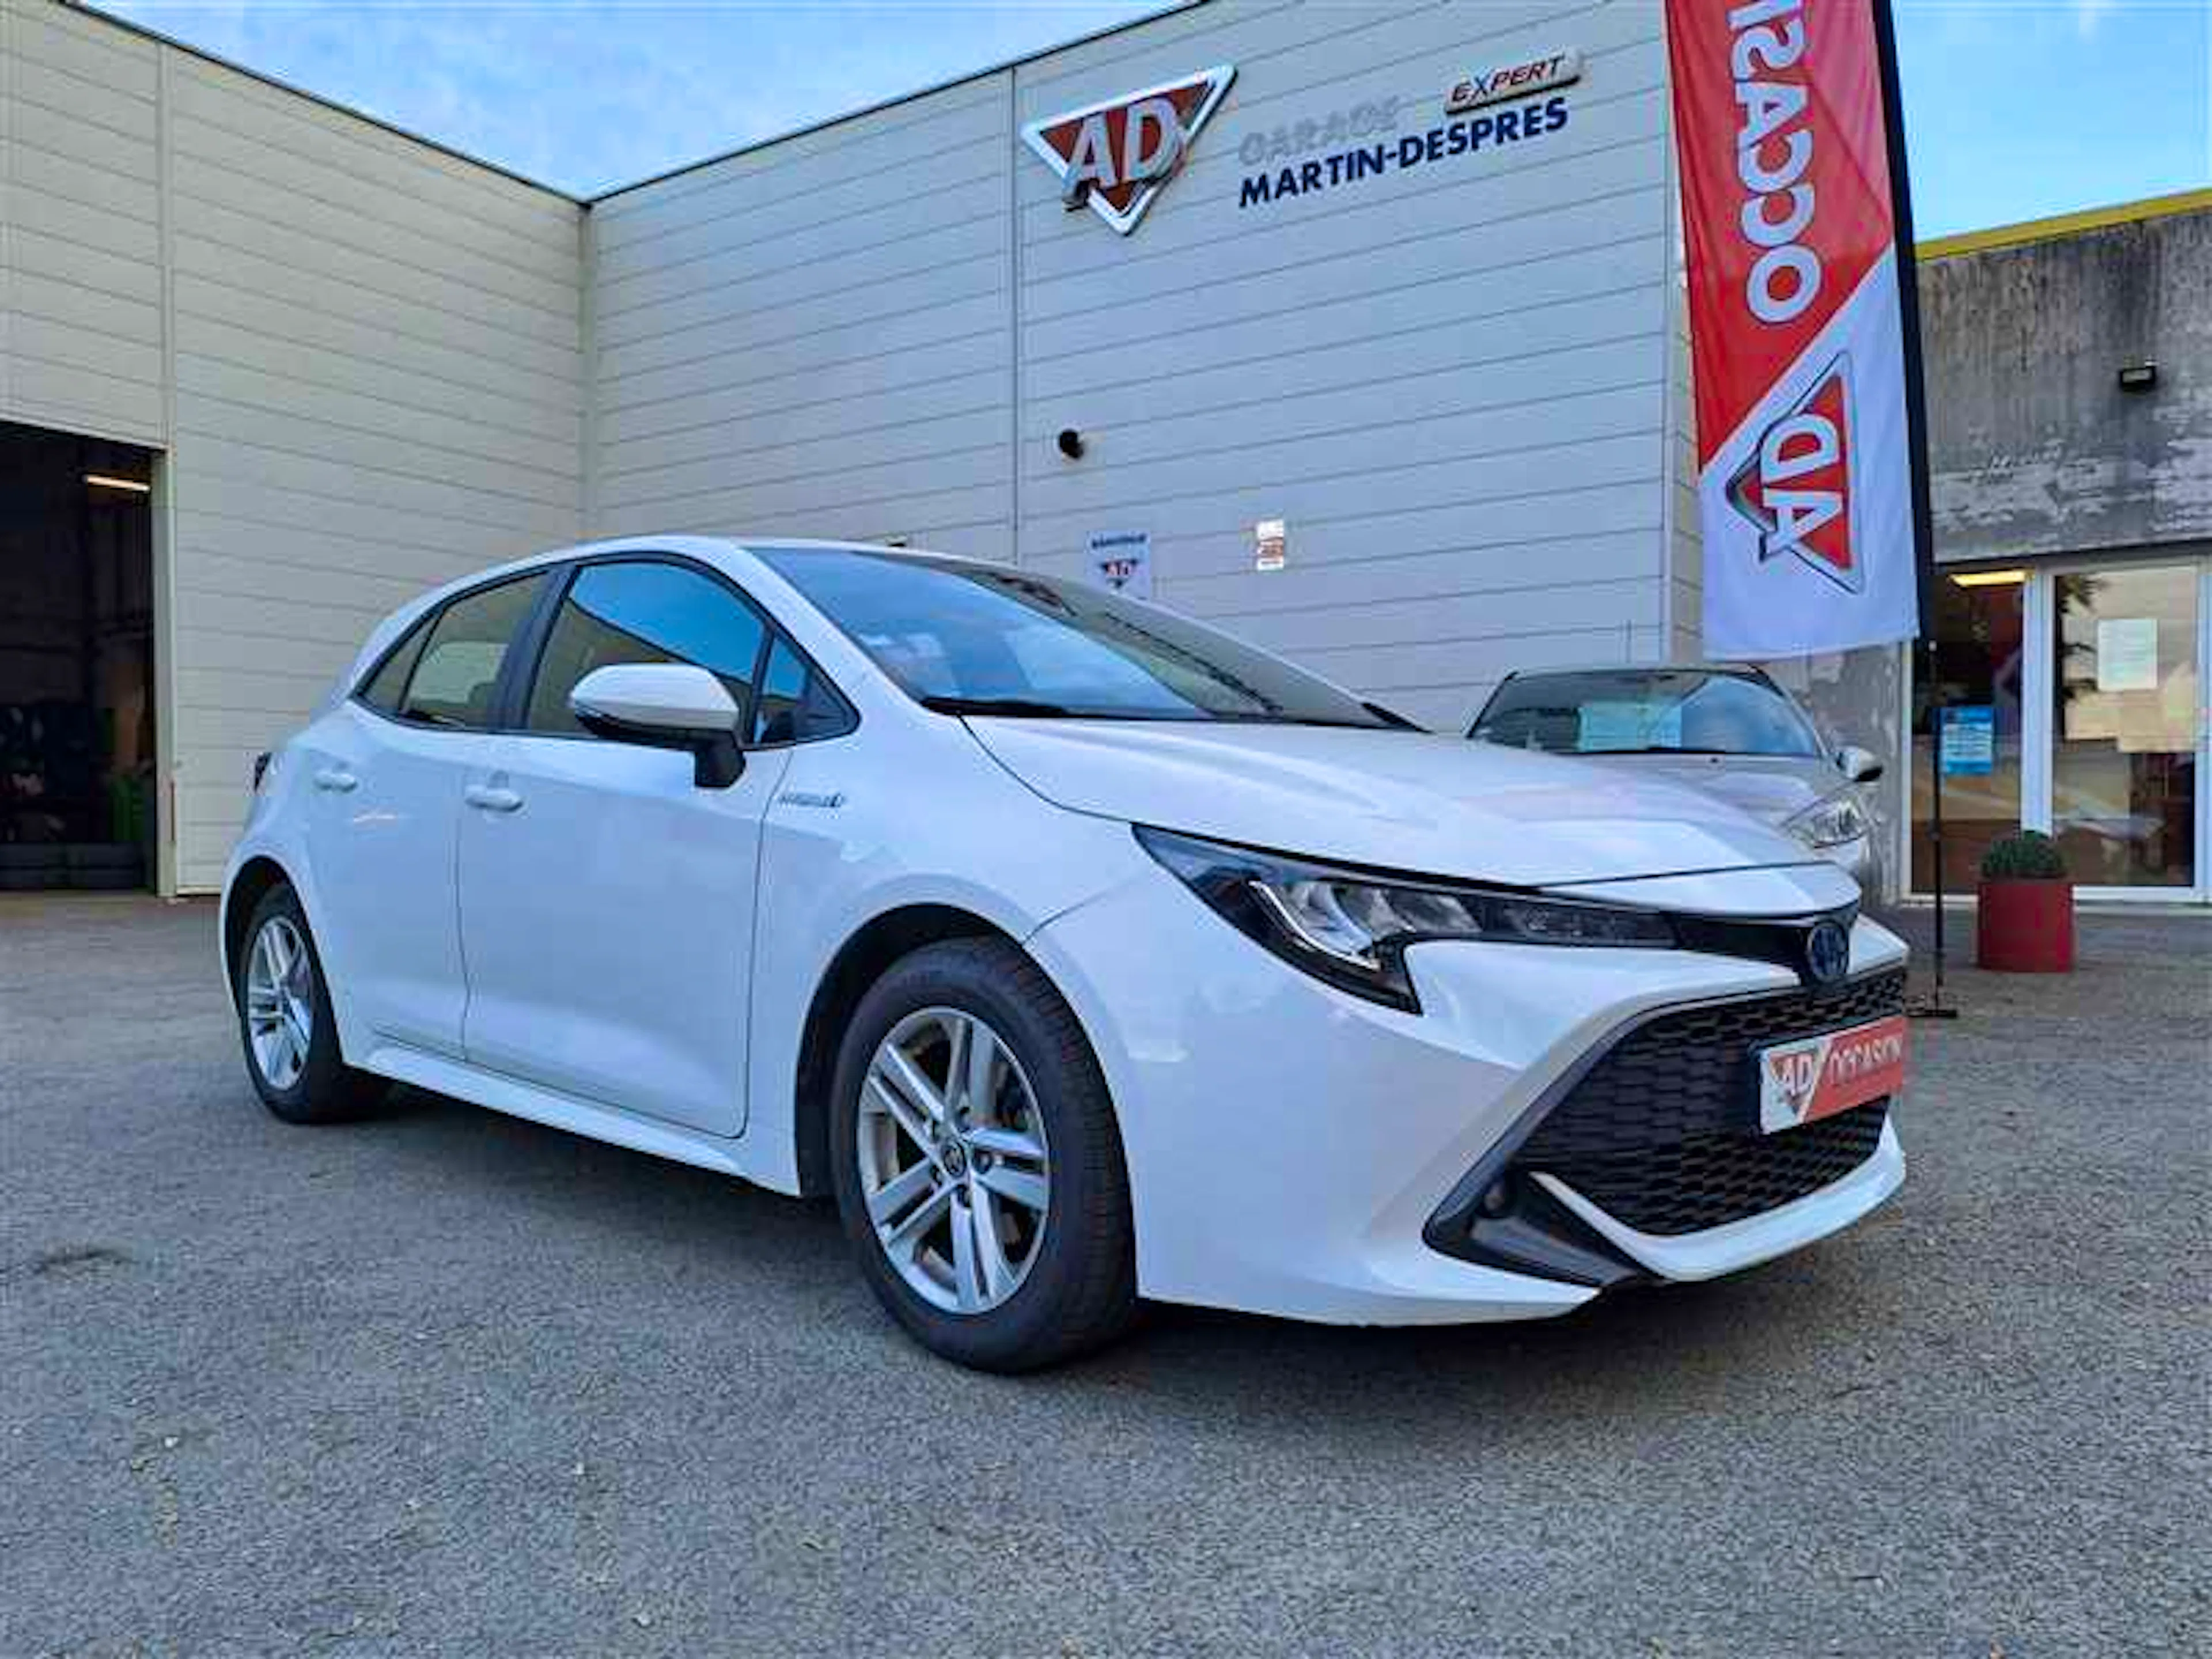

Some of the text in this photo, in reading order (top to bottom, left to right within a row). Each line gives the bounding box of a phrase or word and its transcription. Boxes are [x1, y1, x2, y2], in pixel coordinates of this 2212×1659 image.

[1451, 52, 1566, 103] EXPERT
[1061, 96, 1181, 202] AD
[1238, 97, 1569, 208] MARTIN-DESPRES
[1781, 1053, 1813, 1096] AD
